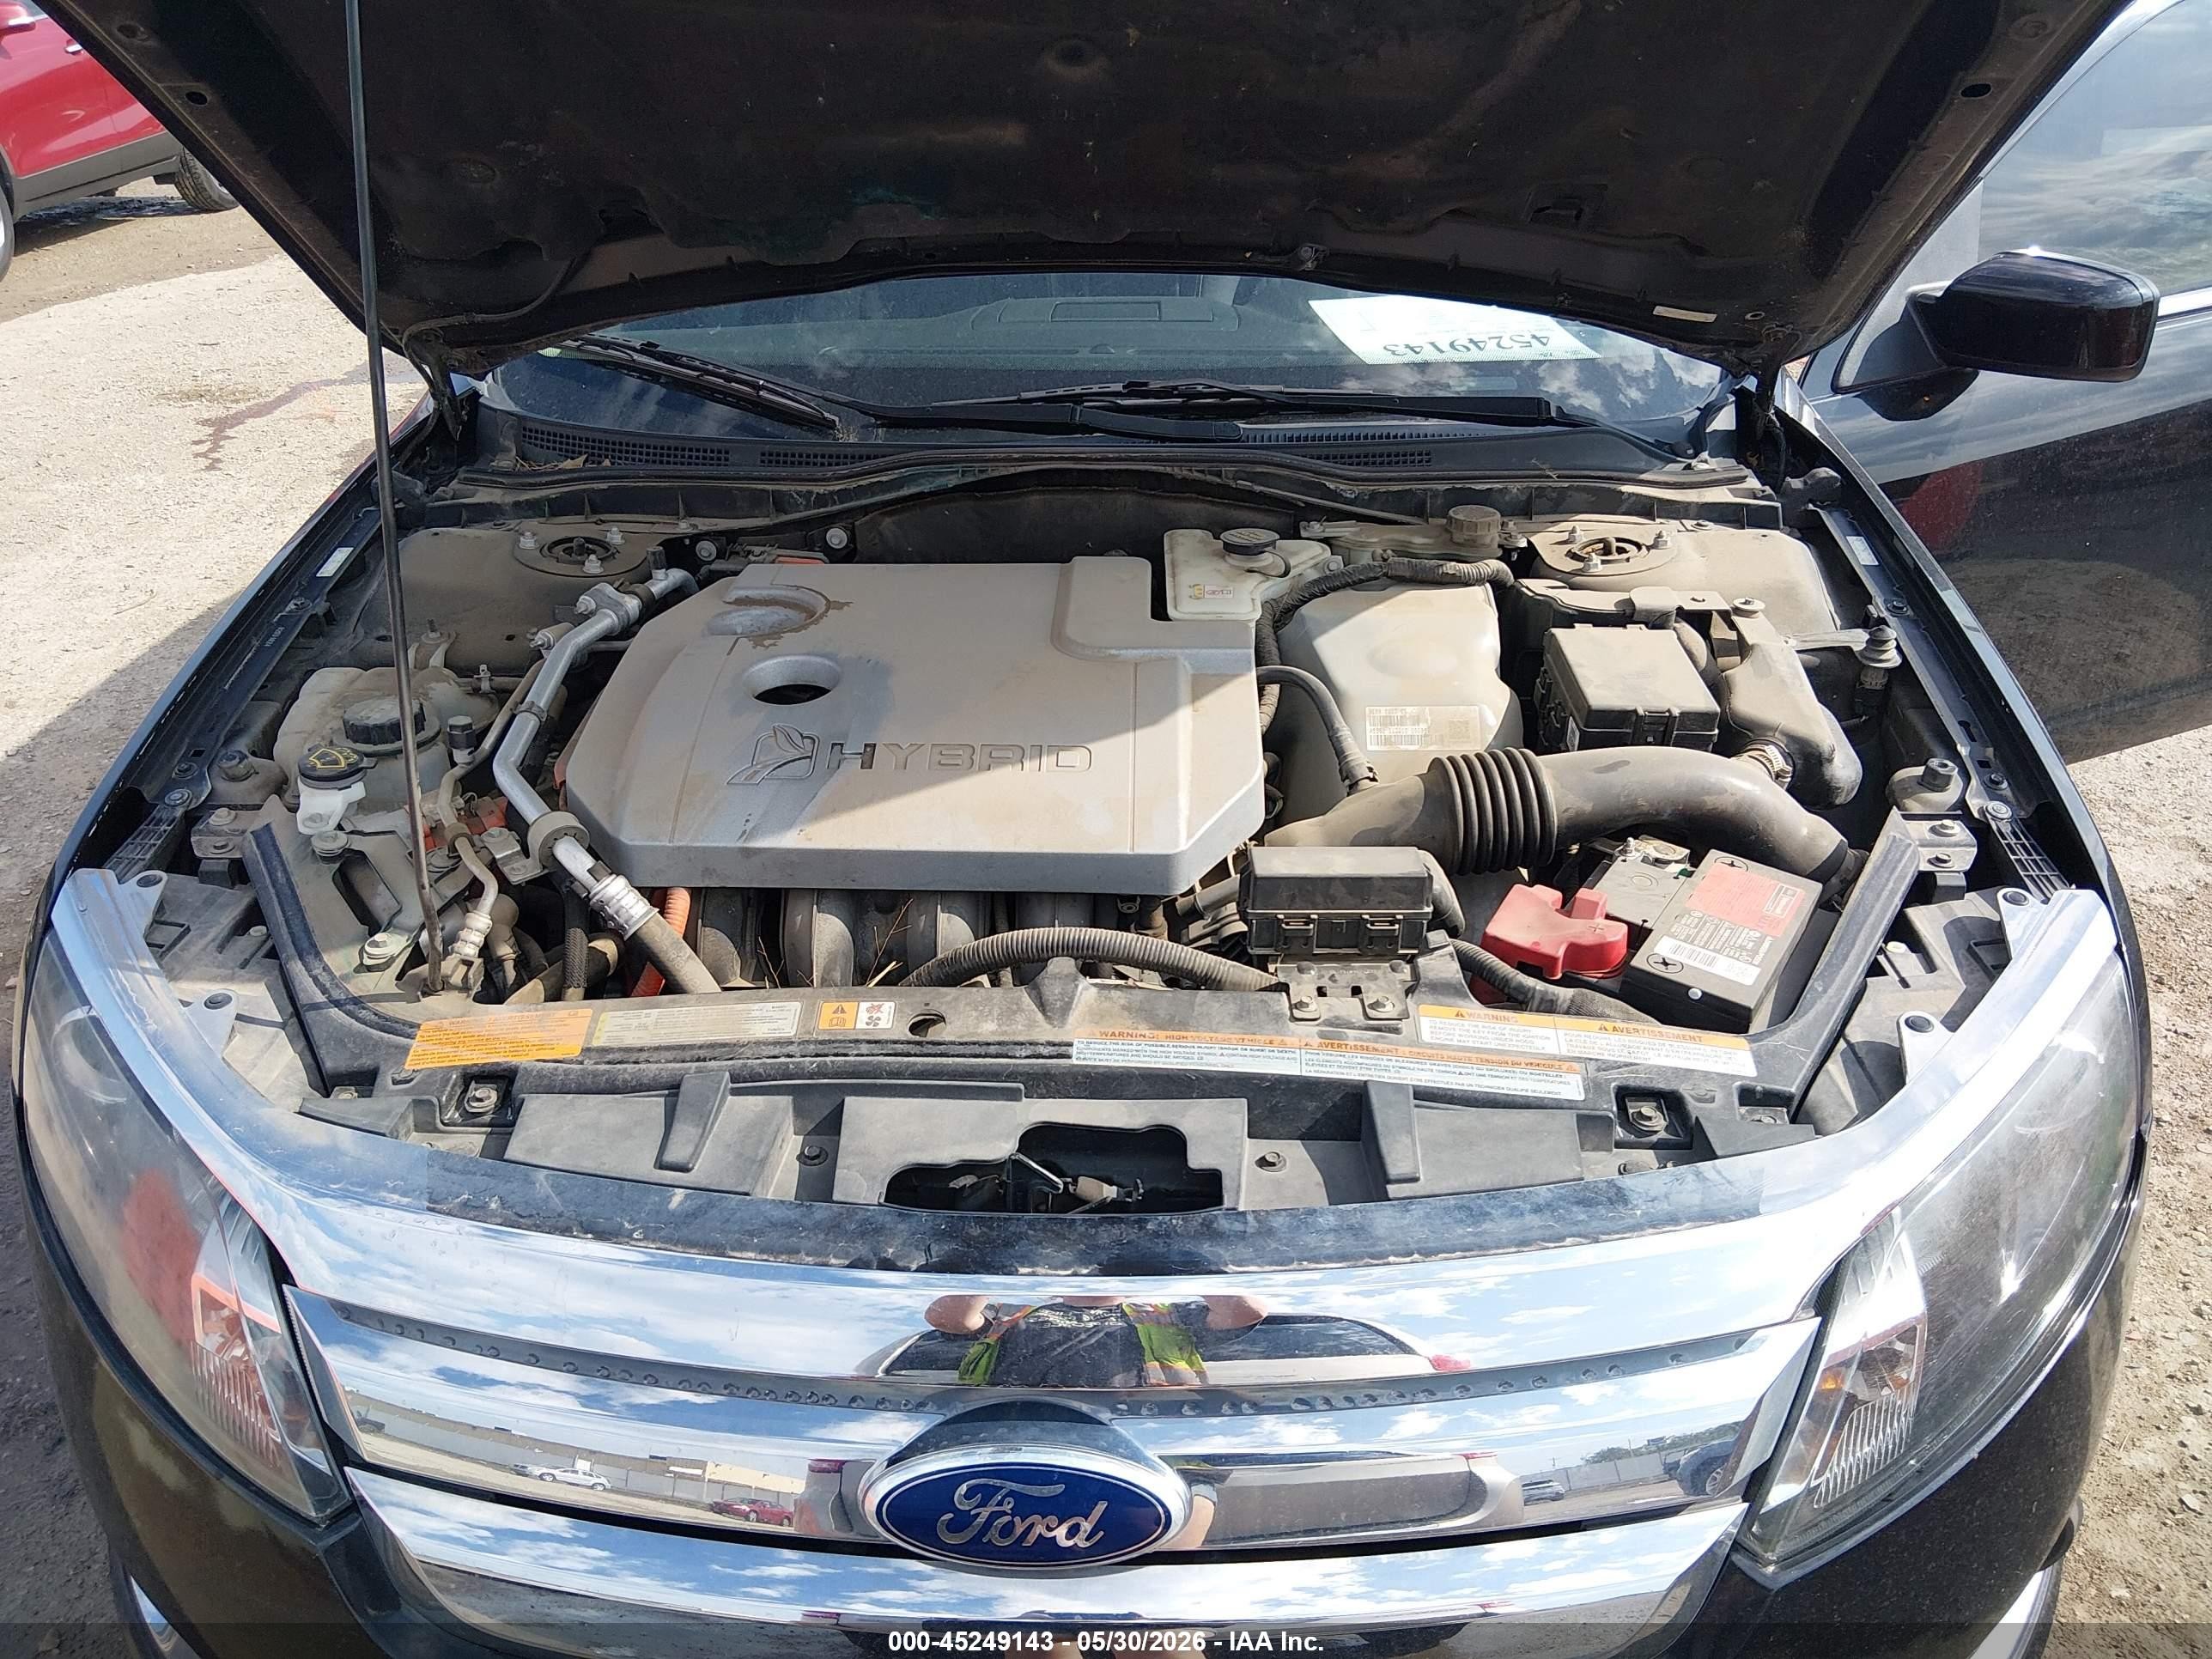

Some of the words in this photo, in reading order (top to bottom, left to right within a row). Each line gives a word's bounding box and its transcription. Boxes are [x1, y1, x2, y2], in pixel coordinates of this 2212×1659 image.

[1383, 333, 1551, 356] 45249143
[827, 742, 1092, 772] HYBRID
[1466, 1011, 1519, 1023] WARNING
[1613, 1025, 1703, 1042] AVERTISSEMENT
[1317, 1042, 1399, 1054] AVERTISSEMENT
[937, 1478, 1108, 1547] Ford
